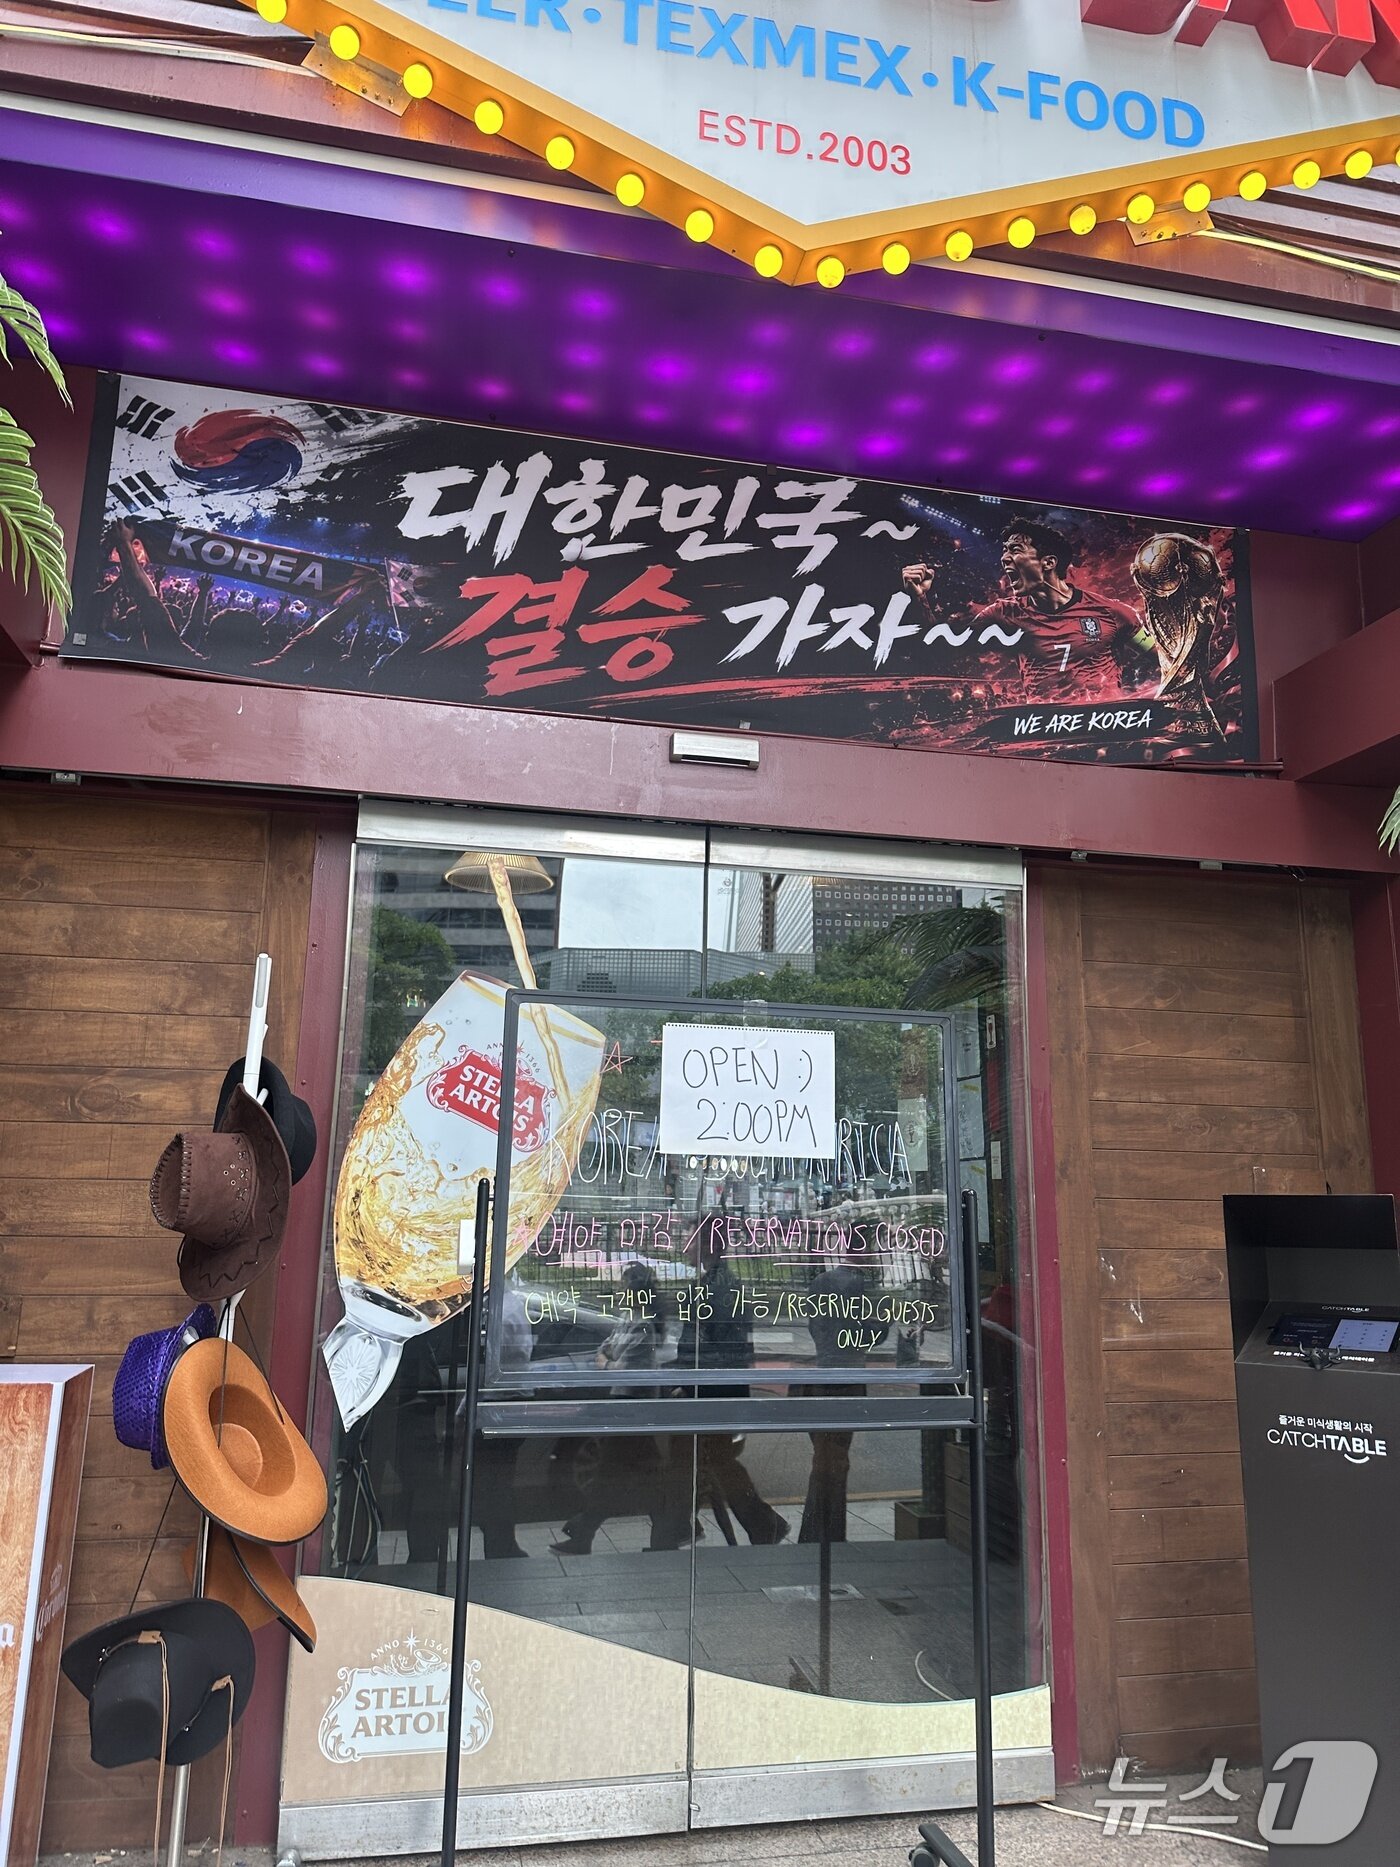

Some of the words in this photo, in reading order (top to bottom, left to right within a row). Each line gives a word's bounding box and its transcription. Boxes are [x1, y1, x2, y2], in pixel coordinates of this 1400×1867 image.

[953, 57, 1205, 149] K-FOOD
[698, 110, 913, 177] ESTD.2003
[166, 527, 324, 593] KOREA
[421, 561, 706, 699] 결승
[1054, 643, 1071, 672] 7
[1014, 713, 1043, 736] WE
[1045, 712, 1084, 734] ARE
[1088, 708, 1152, 732] KOREA
[460, 1065, 535, 1114] STEA
[682, 1046, 779, 1090] OPEN
[449, 1083, 529, 1131] ARTS
[697, 1097, 818, 1148] 2:00PM
[621, 1208, 675, 1249] 마감
[875, 1221, 945, 1258] CLOSED
[525, 1284, 582, 1325] 예약
[597, 1284, 657, 1322] 고객만
[676, 1284, 715, 1322] 입장
[876, 1297, 940, 1325] GUESTS
[837, 1328, 883, 1351] ONLY
[1267, 1428, 1388, 1457] CATCHTABLE
[1278, 1414, 1306, 1427] 즐거운
[1307, 1417, 1352, 1432] 미식생활의
[1354, 1422, 1374, 1434] 시작
[370, 1639, 400, 1661] ANNO
[424, 1638, 449, 1655] 1366
[350, 1711, 446, 1739] ARTOI
